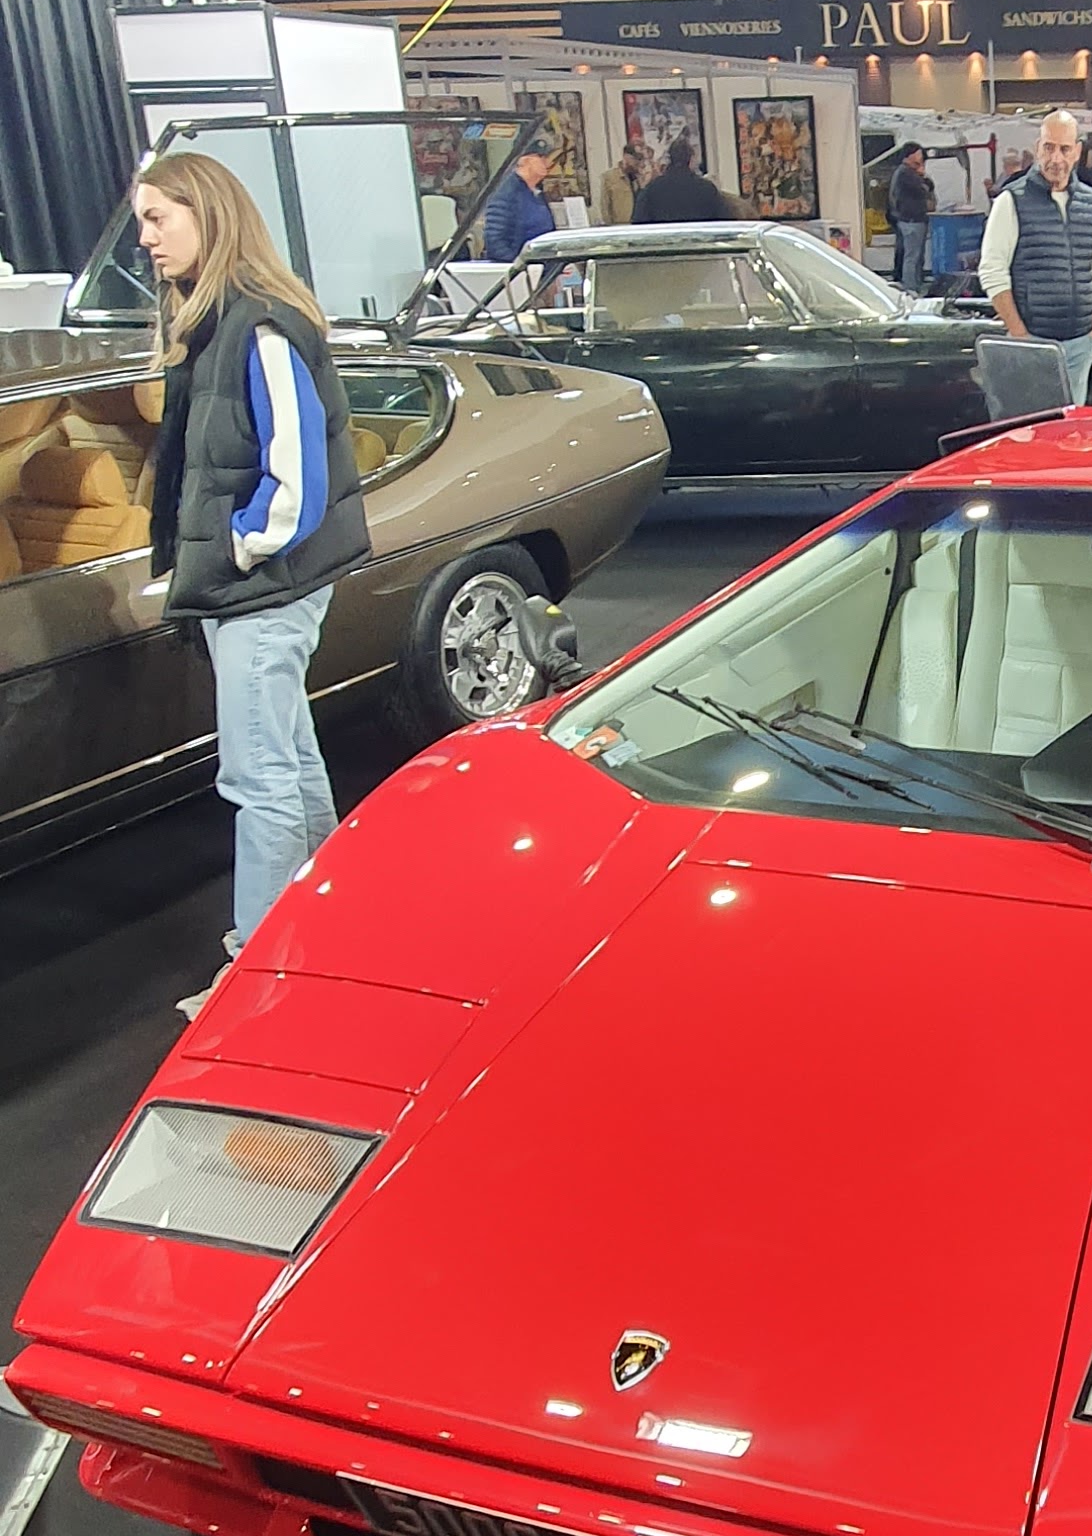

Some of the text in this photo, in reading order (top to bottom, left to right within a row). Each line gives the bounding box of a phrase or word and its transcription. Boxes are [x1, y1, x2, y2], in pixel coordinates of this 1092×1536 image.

[618, 19, 782, 39] CAFÉS VIENNOISERIES
[819, 0, 972, 48] PAUL
